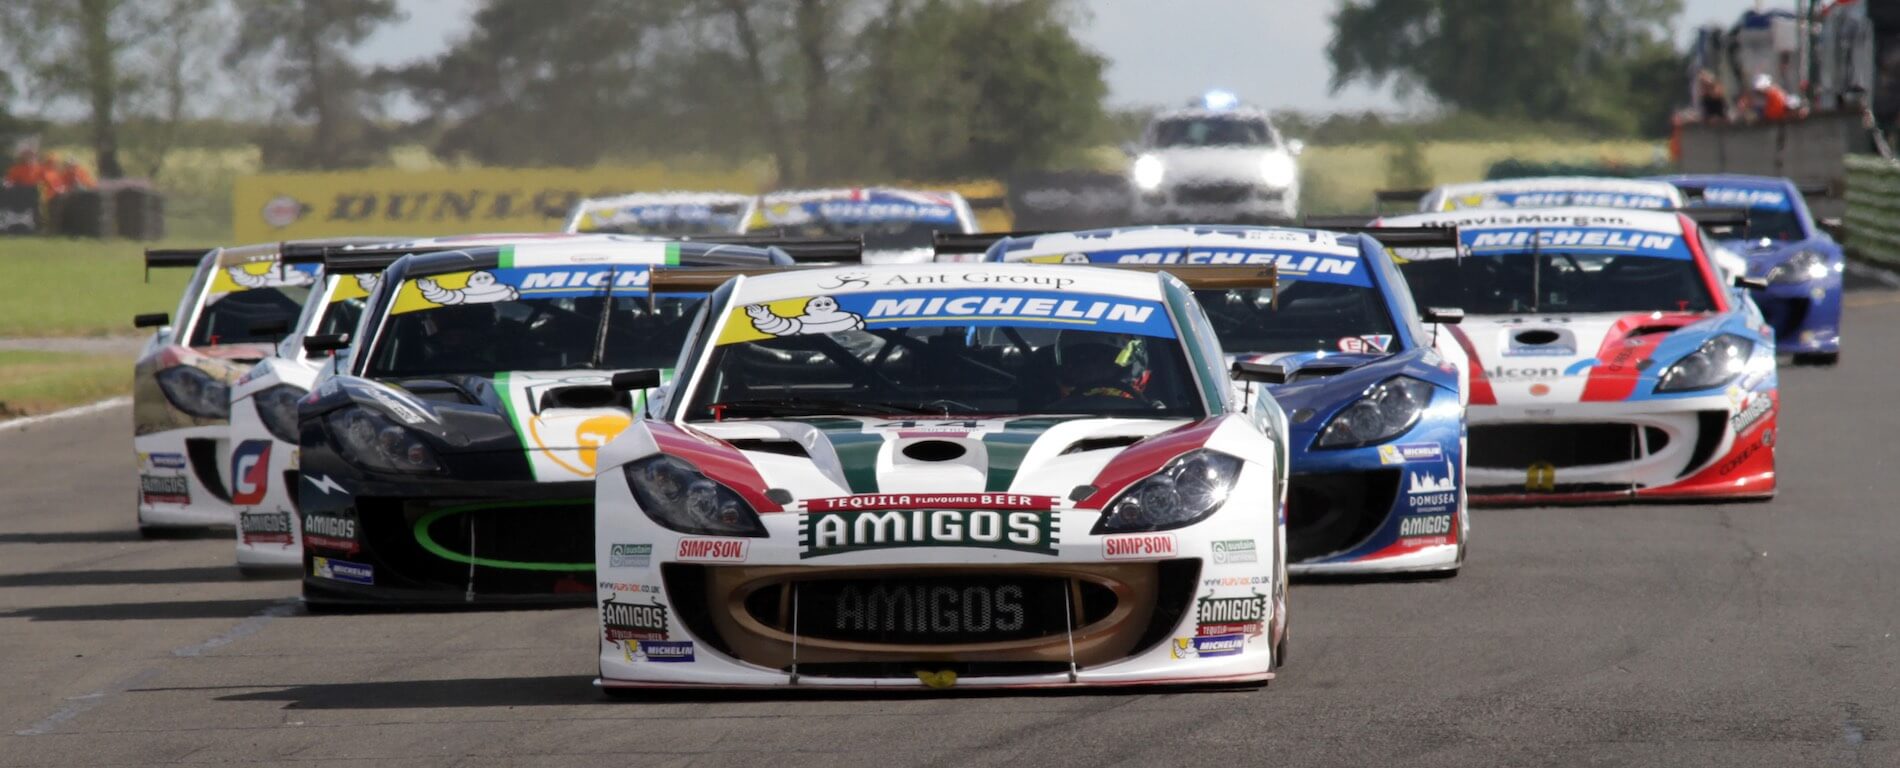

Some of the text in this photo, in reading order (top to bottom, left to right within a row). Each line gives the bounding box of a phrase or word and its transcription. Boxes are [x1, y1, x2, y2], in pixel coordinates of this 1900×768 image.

[1474, 230, 1674, 251] MICHELIN
[884, 272, 1075, 290] Ant Group
[867, 296, 1155, 325] MICHELIN
[827, 496, 911, 508] TEQUILA
[981, 495, 1032, 506] BEER
[1410, 493, 1455, 506] DOMUSEA
[305, 514, 355, 538] AMIGOS
[815, 511, 1042, 549] AMIGOS
[1401, 515, 1450, 535] AMIGOS
[679, 539, 743, 558] SIMPSON
[1106, 537, 1172, 556] SIMPSON
[607, 604, 663, 628] AMIGOS
[834, 584, 1024, 632] AMIGOS
[1201, 600, 1261, 622] AMIGOS
[648, 647, 692, 655] MICHELIN
[1201, 640, 1243, 649] MICHELIN
